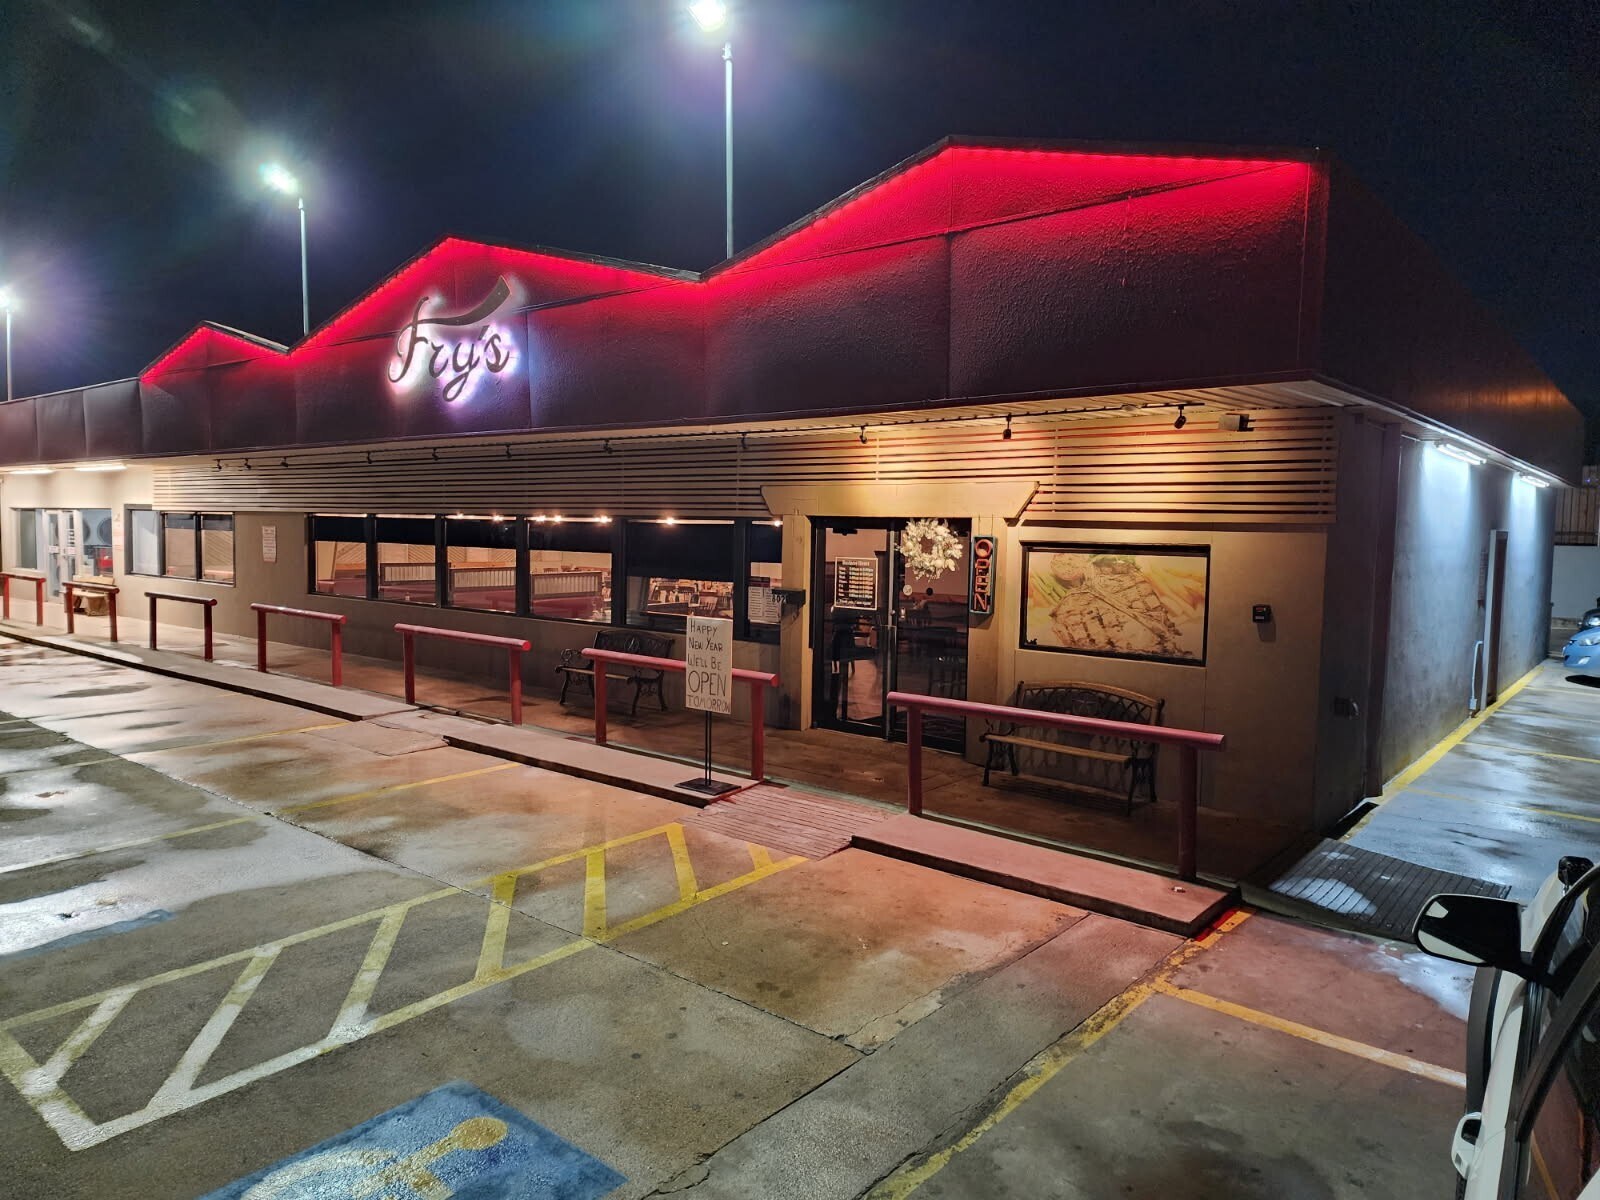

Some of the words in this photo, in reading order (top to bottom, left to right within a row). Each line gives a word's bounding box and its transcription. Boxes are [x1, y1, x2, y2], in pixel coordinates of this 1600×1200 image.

[387, 275, 511, 402] Fry's
[974, 538, 993, 612] OPEN
[690, 619, 718, 636] HAPPY
[688, 637, 703, 650] NEW
[705, 637, 724, 653] YEAR
[711, 656, 722, 671] BE
[687, 670, 727, 697] OPEN
[687, 694, 730, 713] TOMORROW
